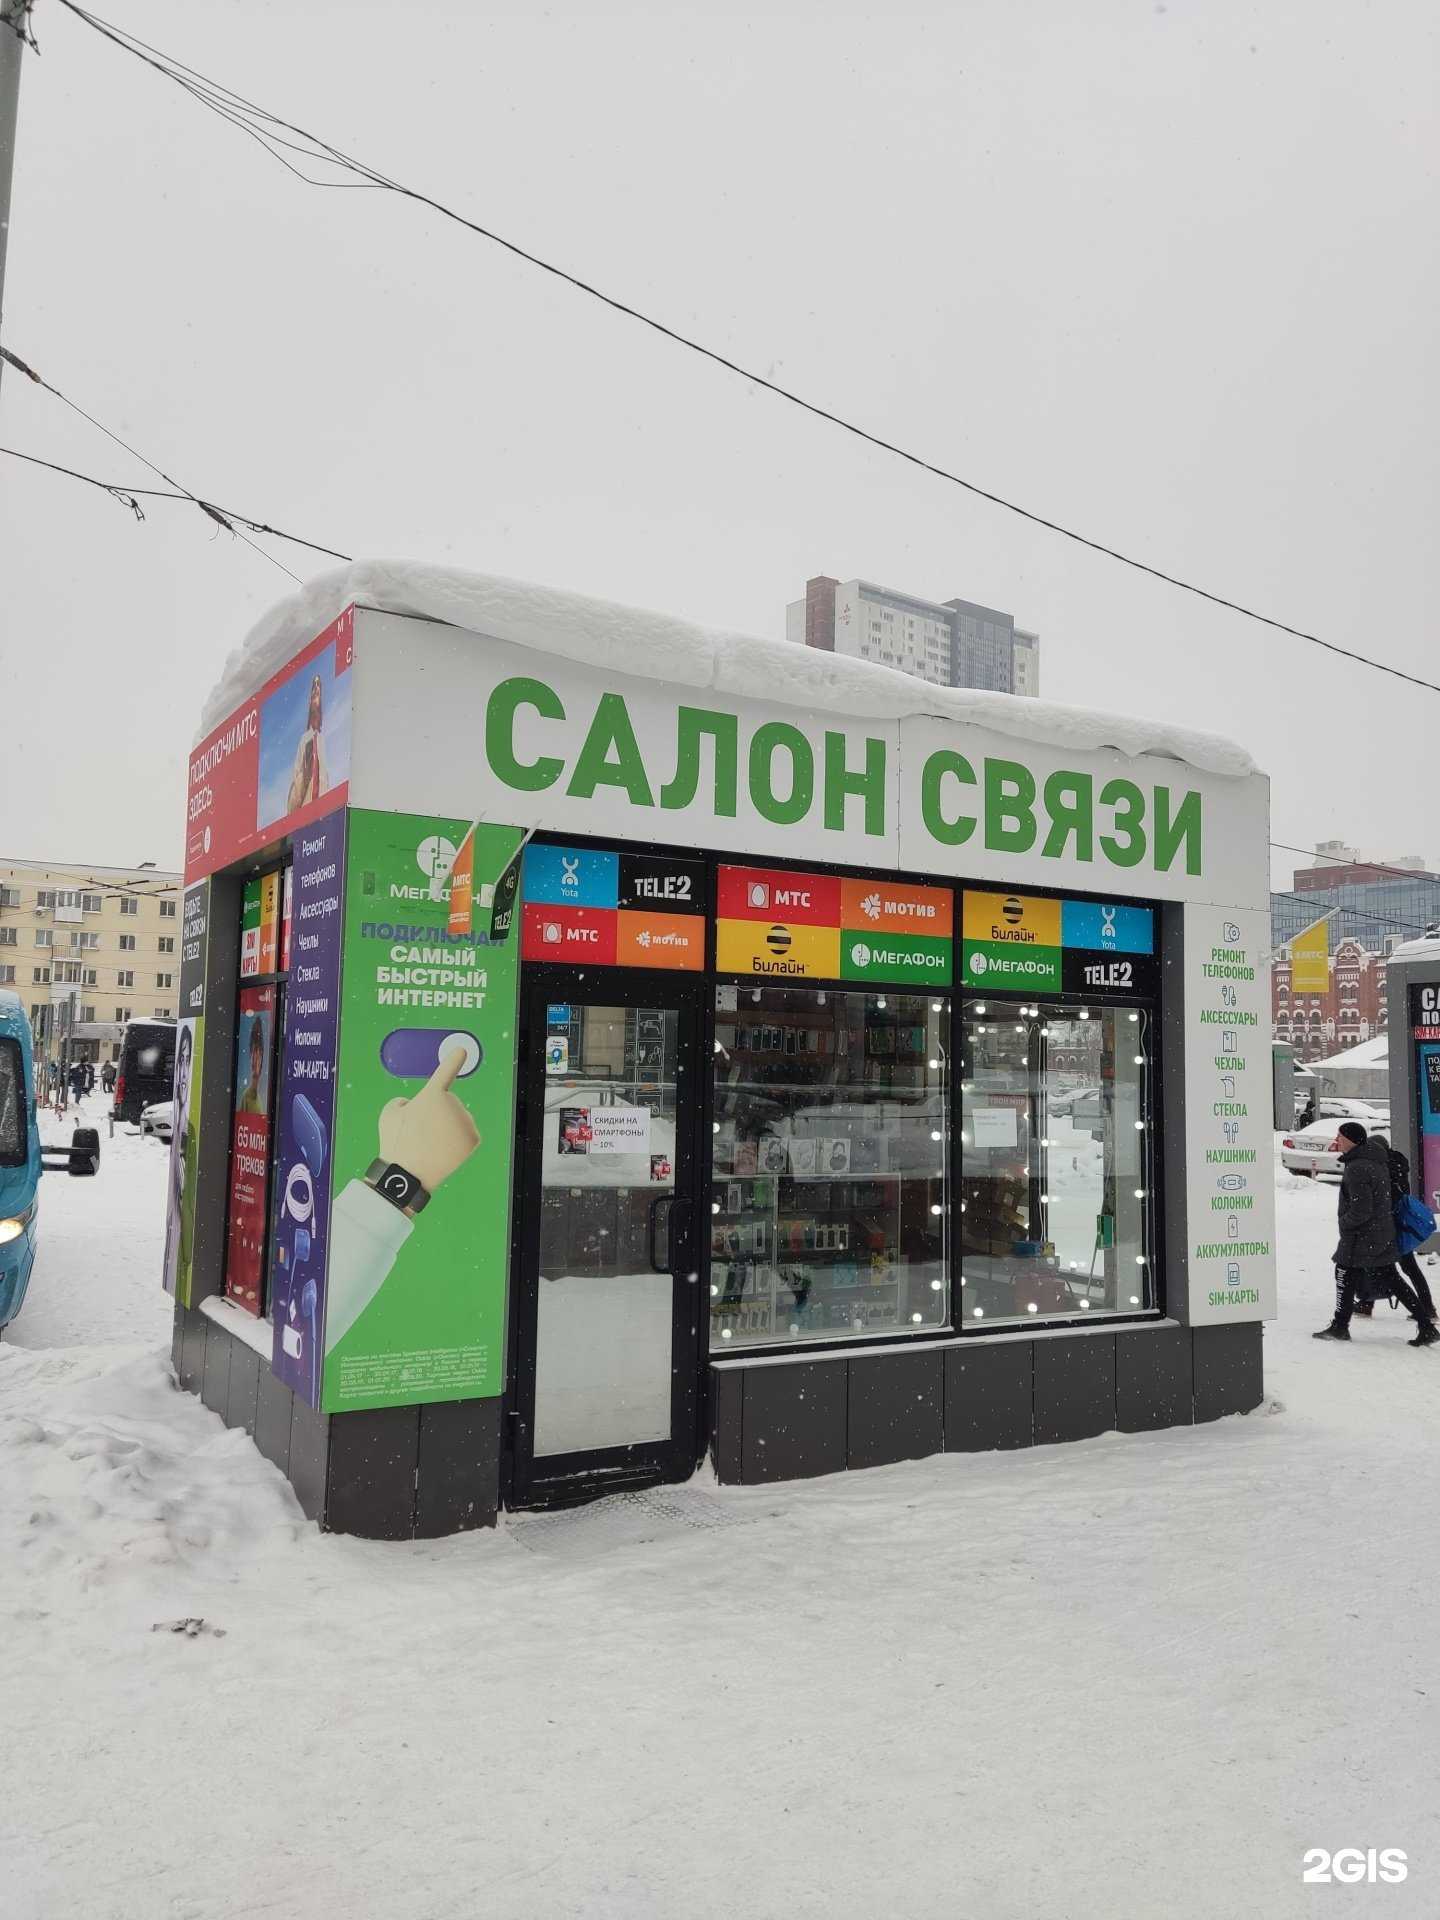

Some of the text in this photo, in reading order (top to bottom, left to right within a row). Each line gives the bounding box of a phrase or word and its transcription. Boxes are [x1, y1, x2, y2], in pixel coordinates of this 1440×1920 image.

[190, 708, 258, 785] ПОДКЛЮЧИ МТС
[485, 676, 1202, 877] САЛОН СВЯЗИ
[188, 784, 214, 822] ЗДЕСЬ
[302, 836, 326, 858] Ремонт
[301, 864, 336, 888] телефонов
[560, 887, 578, 898] Yota
[634, 875, 692, 901] TELE2
[774, 889, 811, 907] МТС
[300, 896, 339, 920] Аксессуары
[298, 934, 319, 951] Чехлы
[361, 921, 505, 947] ПОДКЛЮЧА
[566, 928, 599, 943] МТС
[991, 925, 1035, 942] Билайн
[1101, 939, 1116, 950] Yota
[390, 945, 476, 967] САМЫЙ
[1211, 948, 1246, 963] РЕМОНТ
[297, 965, 320, 983] Стекла
[752, 957, 805, 974] Билайн
[1083, 961, 1133, 988] TELE2
[1202, 963, 1255, 981] ТЕЛЕФОНОВ
[376, 966, 488, 988] БЫСТРЫЙ
[296, 997, 328, 1018] Наушники
[377, 988, 486, 1009] ИНТЕРНЕТ
[1200, 1010, 1258, 1026] АКСЕССУАРЫ
[294, 1028, 321, 1046] Колонки
[293, 1060, 329, 1080] SIM-КАРТЫ
[1214, 1056, 1246, 1071] ЧЕХЛЫ
[1213, 1103, 1248, 1116] СТЕКЛА
[594, 1117, 638, 1126] СКИДКИ НА
[237, 1125, 249, 1148] 65
[594, 1128, 645, 1137] СМАРТФОНЫ
[1205, 1149, 1257, 1163] НАУШНИКИ
[236, 1154, 266, 1179] треков
[1211, 1196, 1253, 1210] КОЛОНКИ
[1196, 1242, 1269, 1259] АККУМУЛЯТОРЫ
[1208, 1288, 1260, 1306] SIM-КАРТЫ
